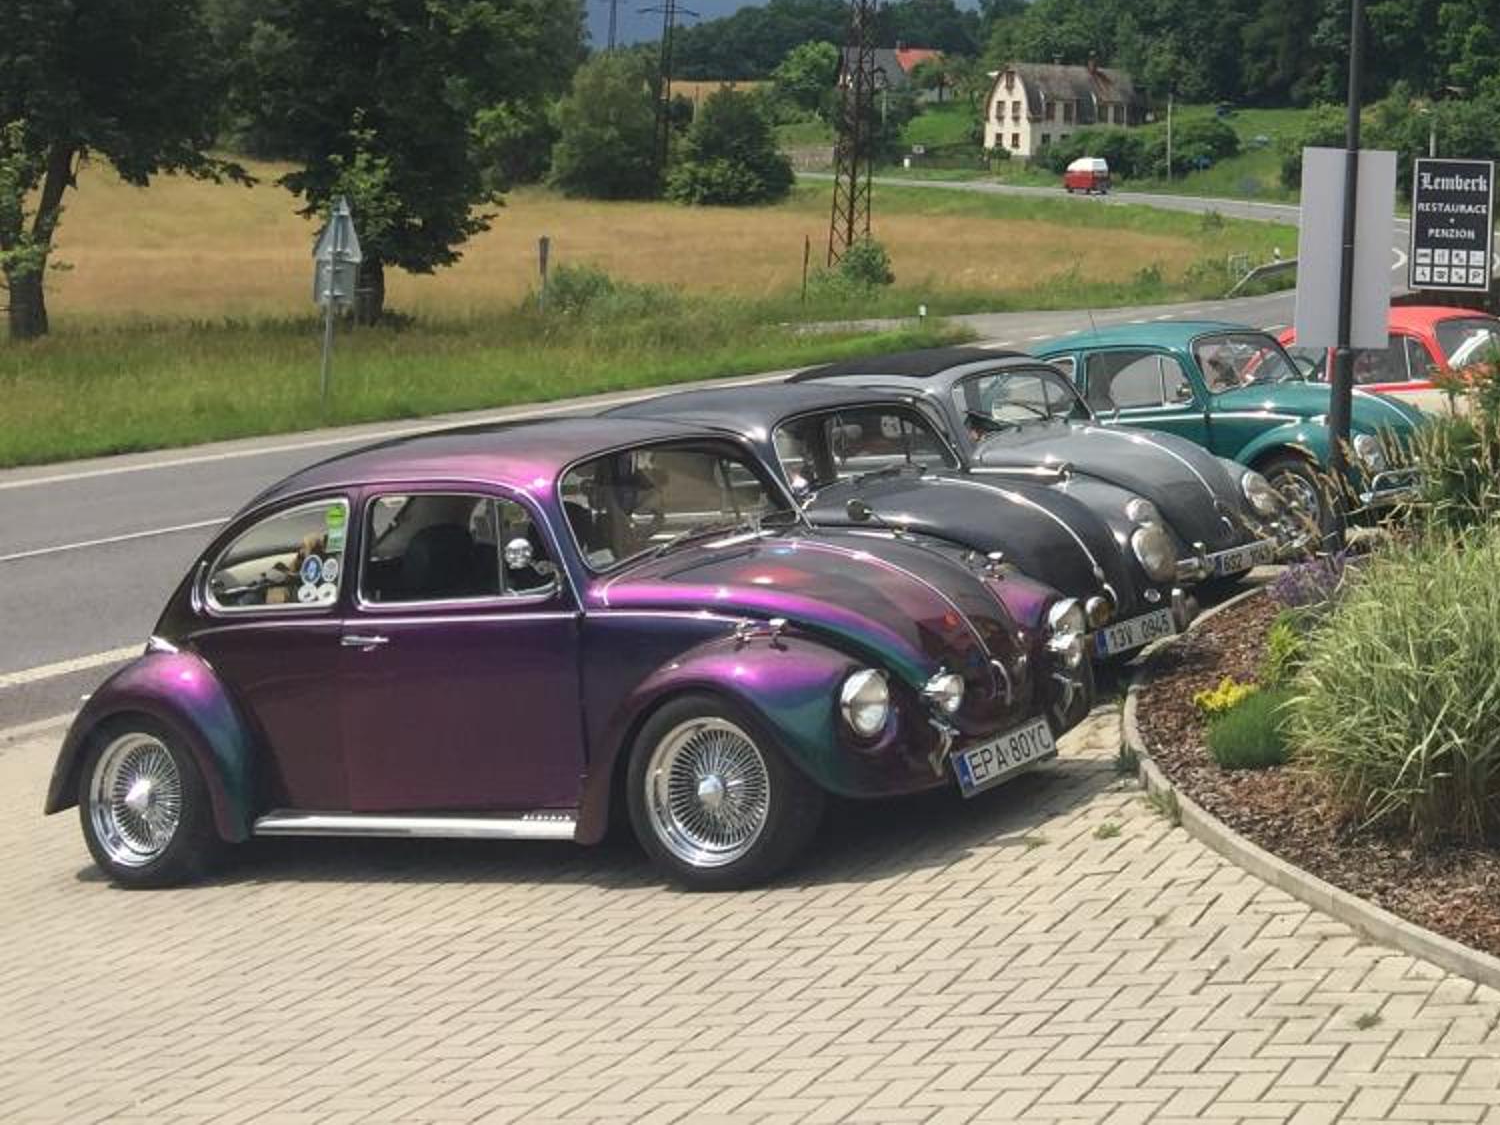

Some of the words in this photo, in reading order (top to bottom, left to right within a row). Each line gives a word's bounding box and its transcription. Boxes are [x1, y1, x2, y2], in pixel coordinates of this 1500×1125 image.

[1420, 172, 1488, 191] Lemberk
[1418, 202, 1487, 214] RESTAURACE
[1428, 228, 1475, 239] PENZION
[967, 743, 1008, 781] EPA
